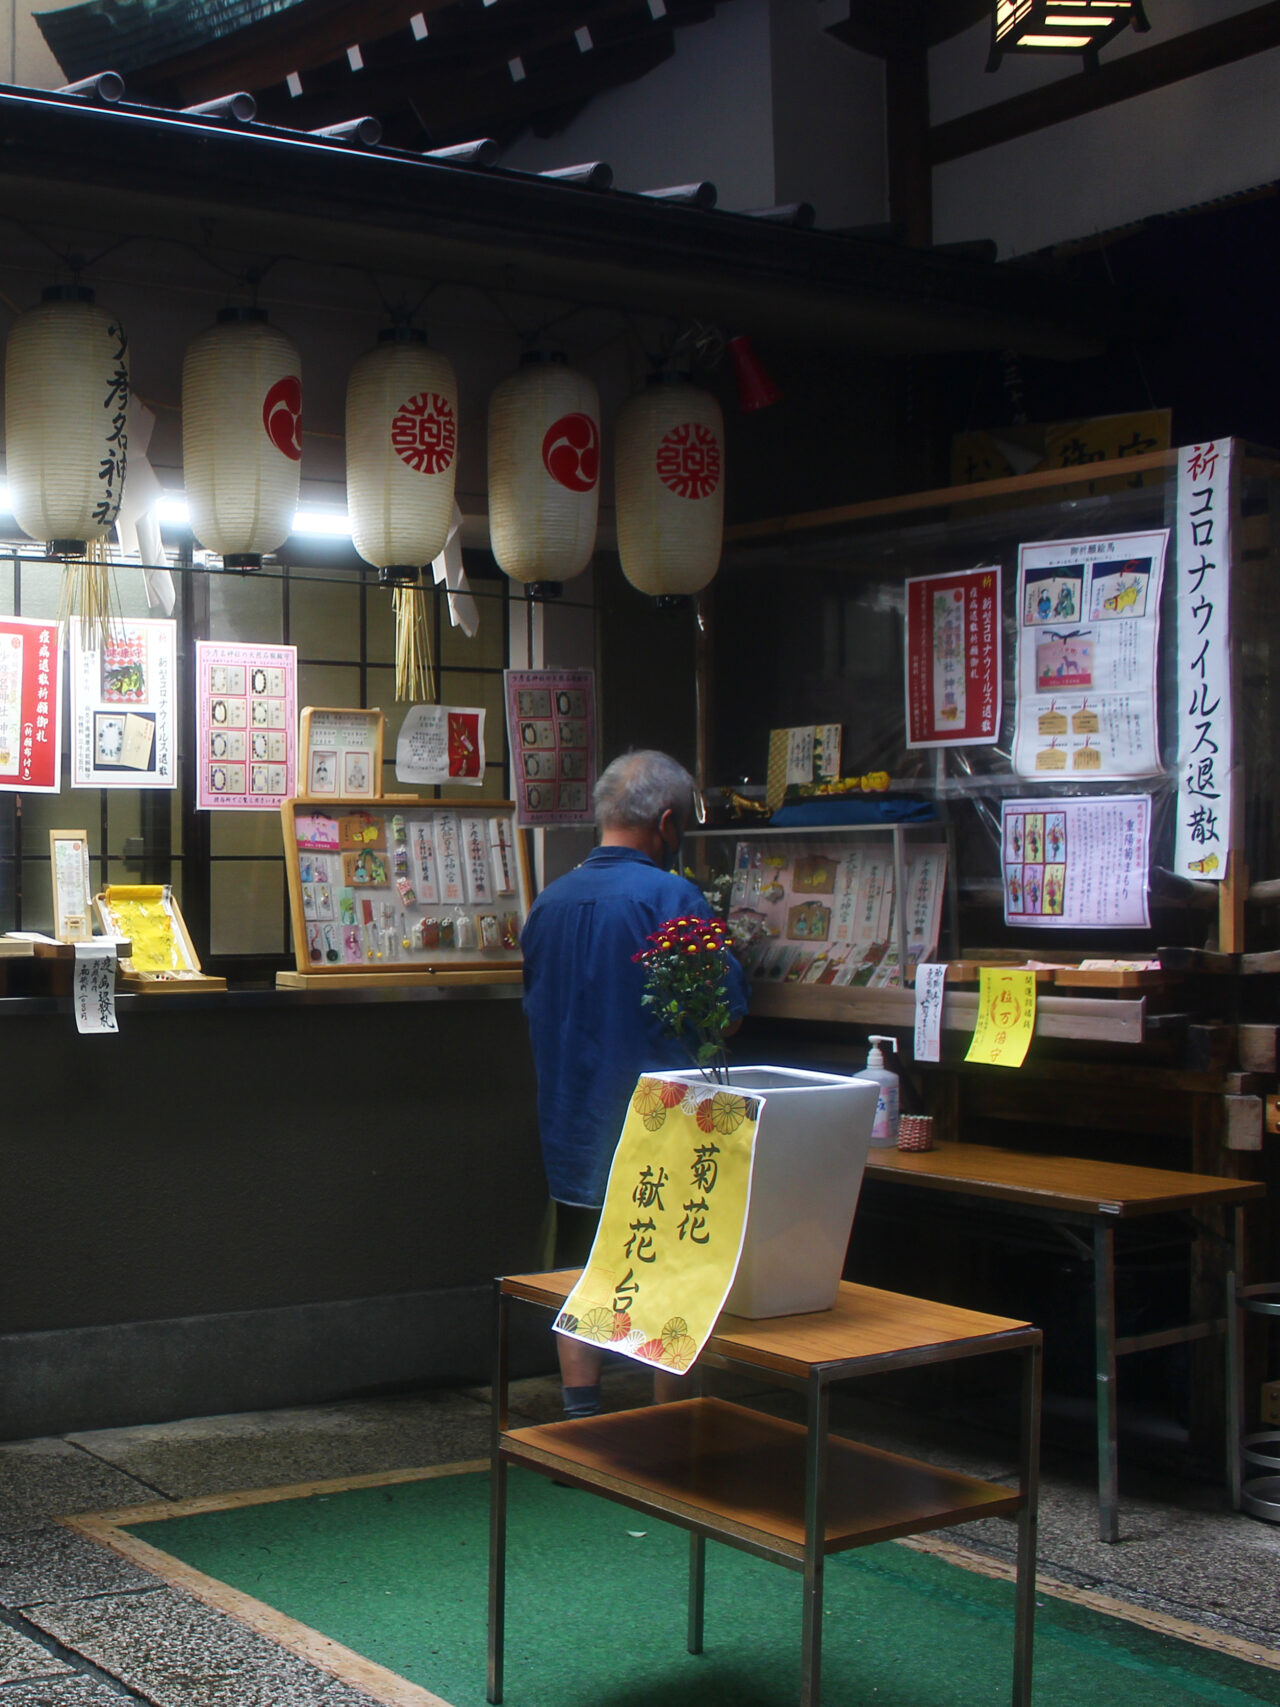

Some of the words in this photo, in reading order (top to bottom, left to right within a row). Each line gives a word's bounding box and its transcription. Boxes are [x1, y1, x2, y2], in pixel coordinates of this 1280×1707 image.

[35, 629, 51, 744] 疫病退散祈願御札
[1183, 443, 1223, 845] 祈コロナウイルス退散
[612, 1164, 670, 1315] 献花台
[676, 1142, 721, 1245] 菊花
